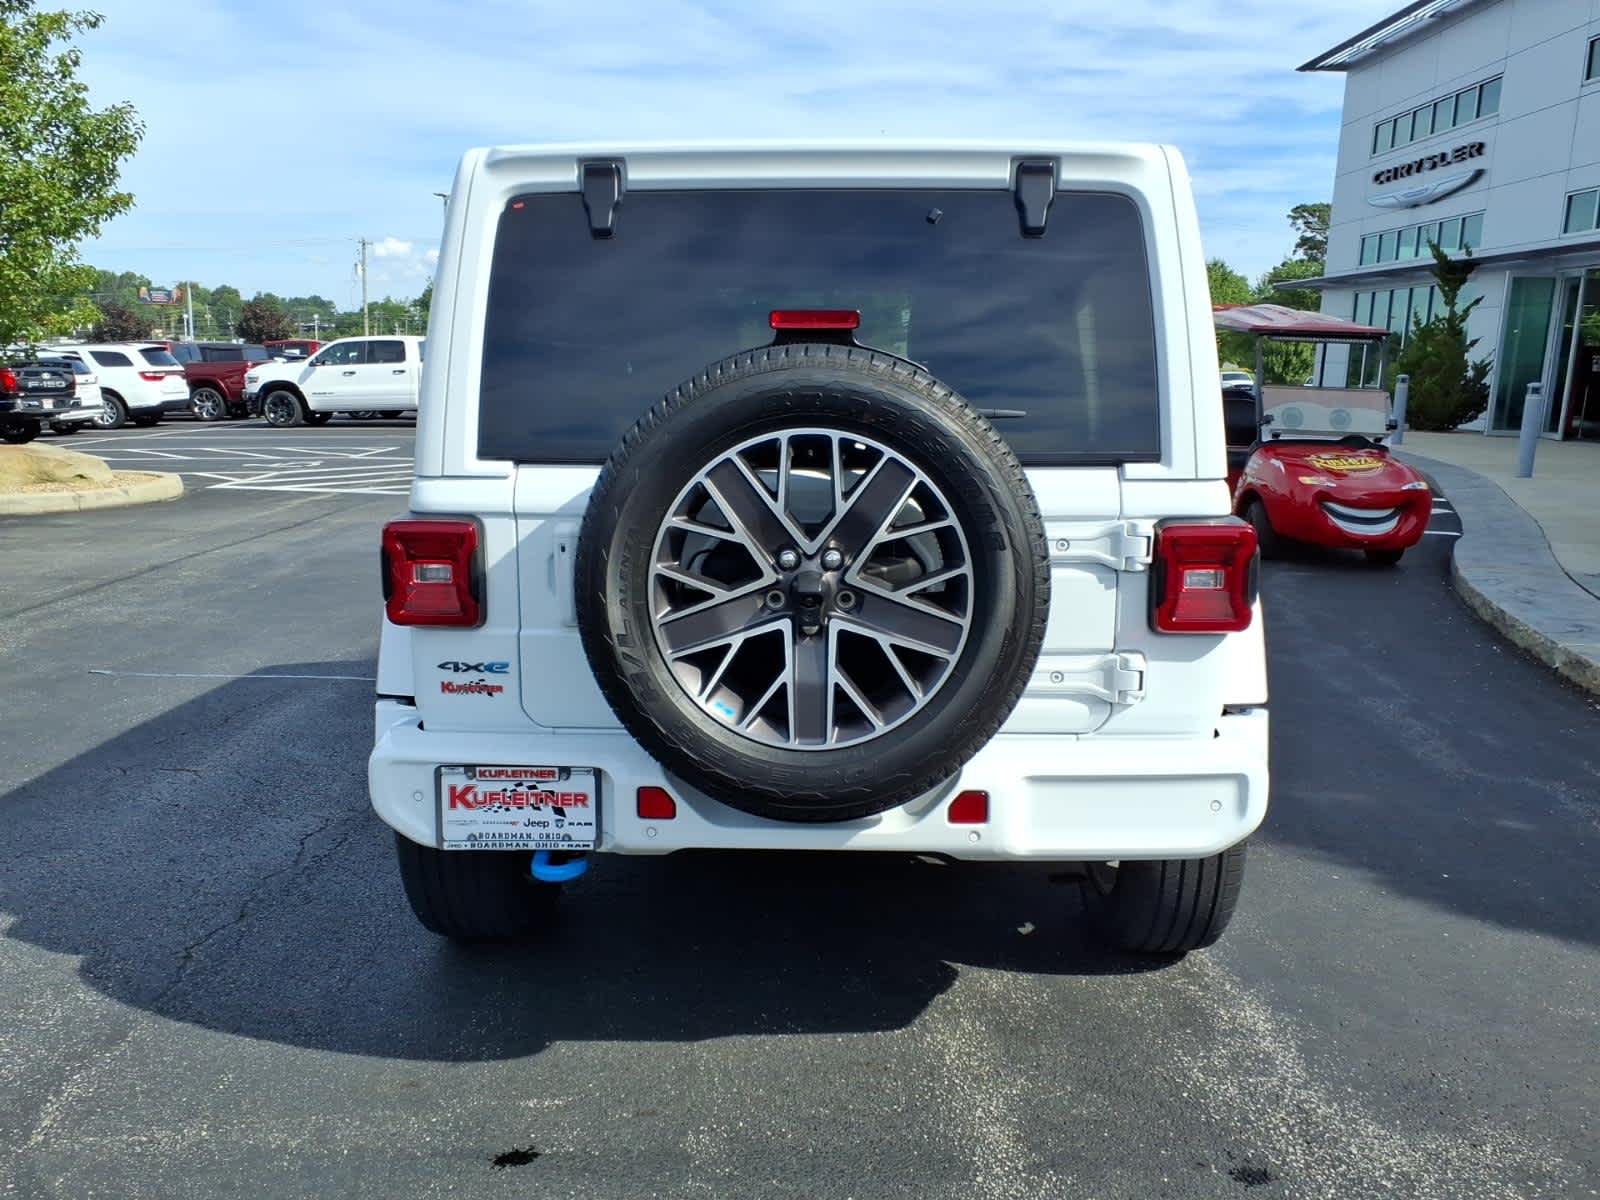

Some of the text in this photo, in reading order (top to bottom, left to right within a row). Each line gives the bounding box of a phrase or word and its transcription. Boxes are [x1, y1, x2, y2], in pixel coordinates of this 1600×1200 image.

[1373, 142, 1486, 185] CHRYSLER
[478, 769, 557, 779] KUFLEITNER
[448, 784, 590, 811] KUFLEITNER
[523, 818, 550, 830] Jeep
